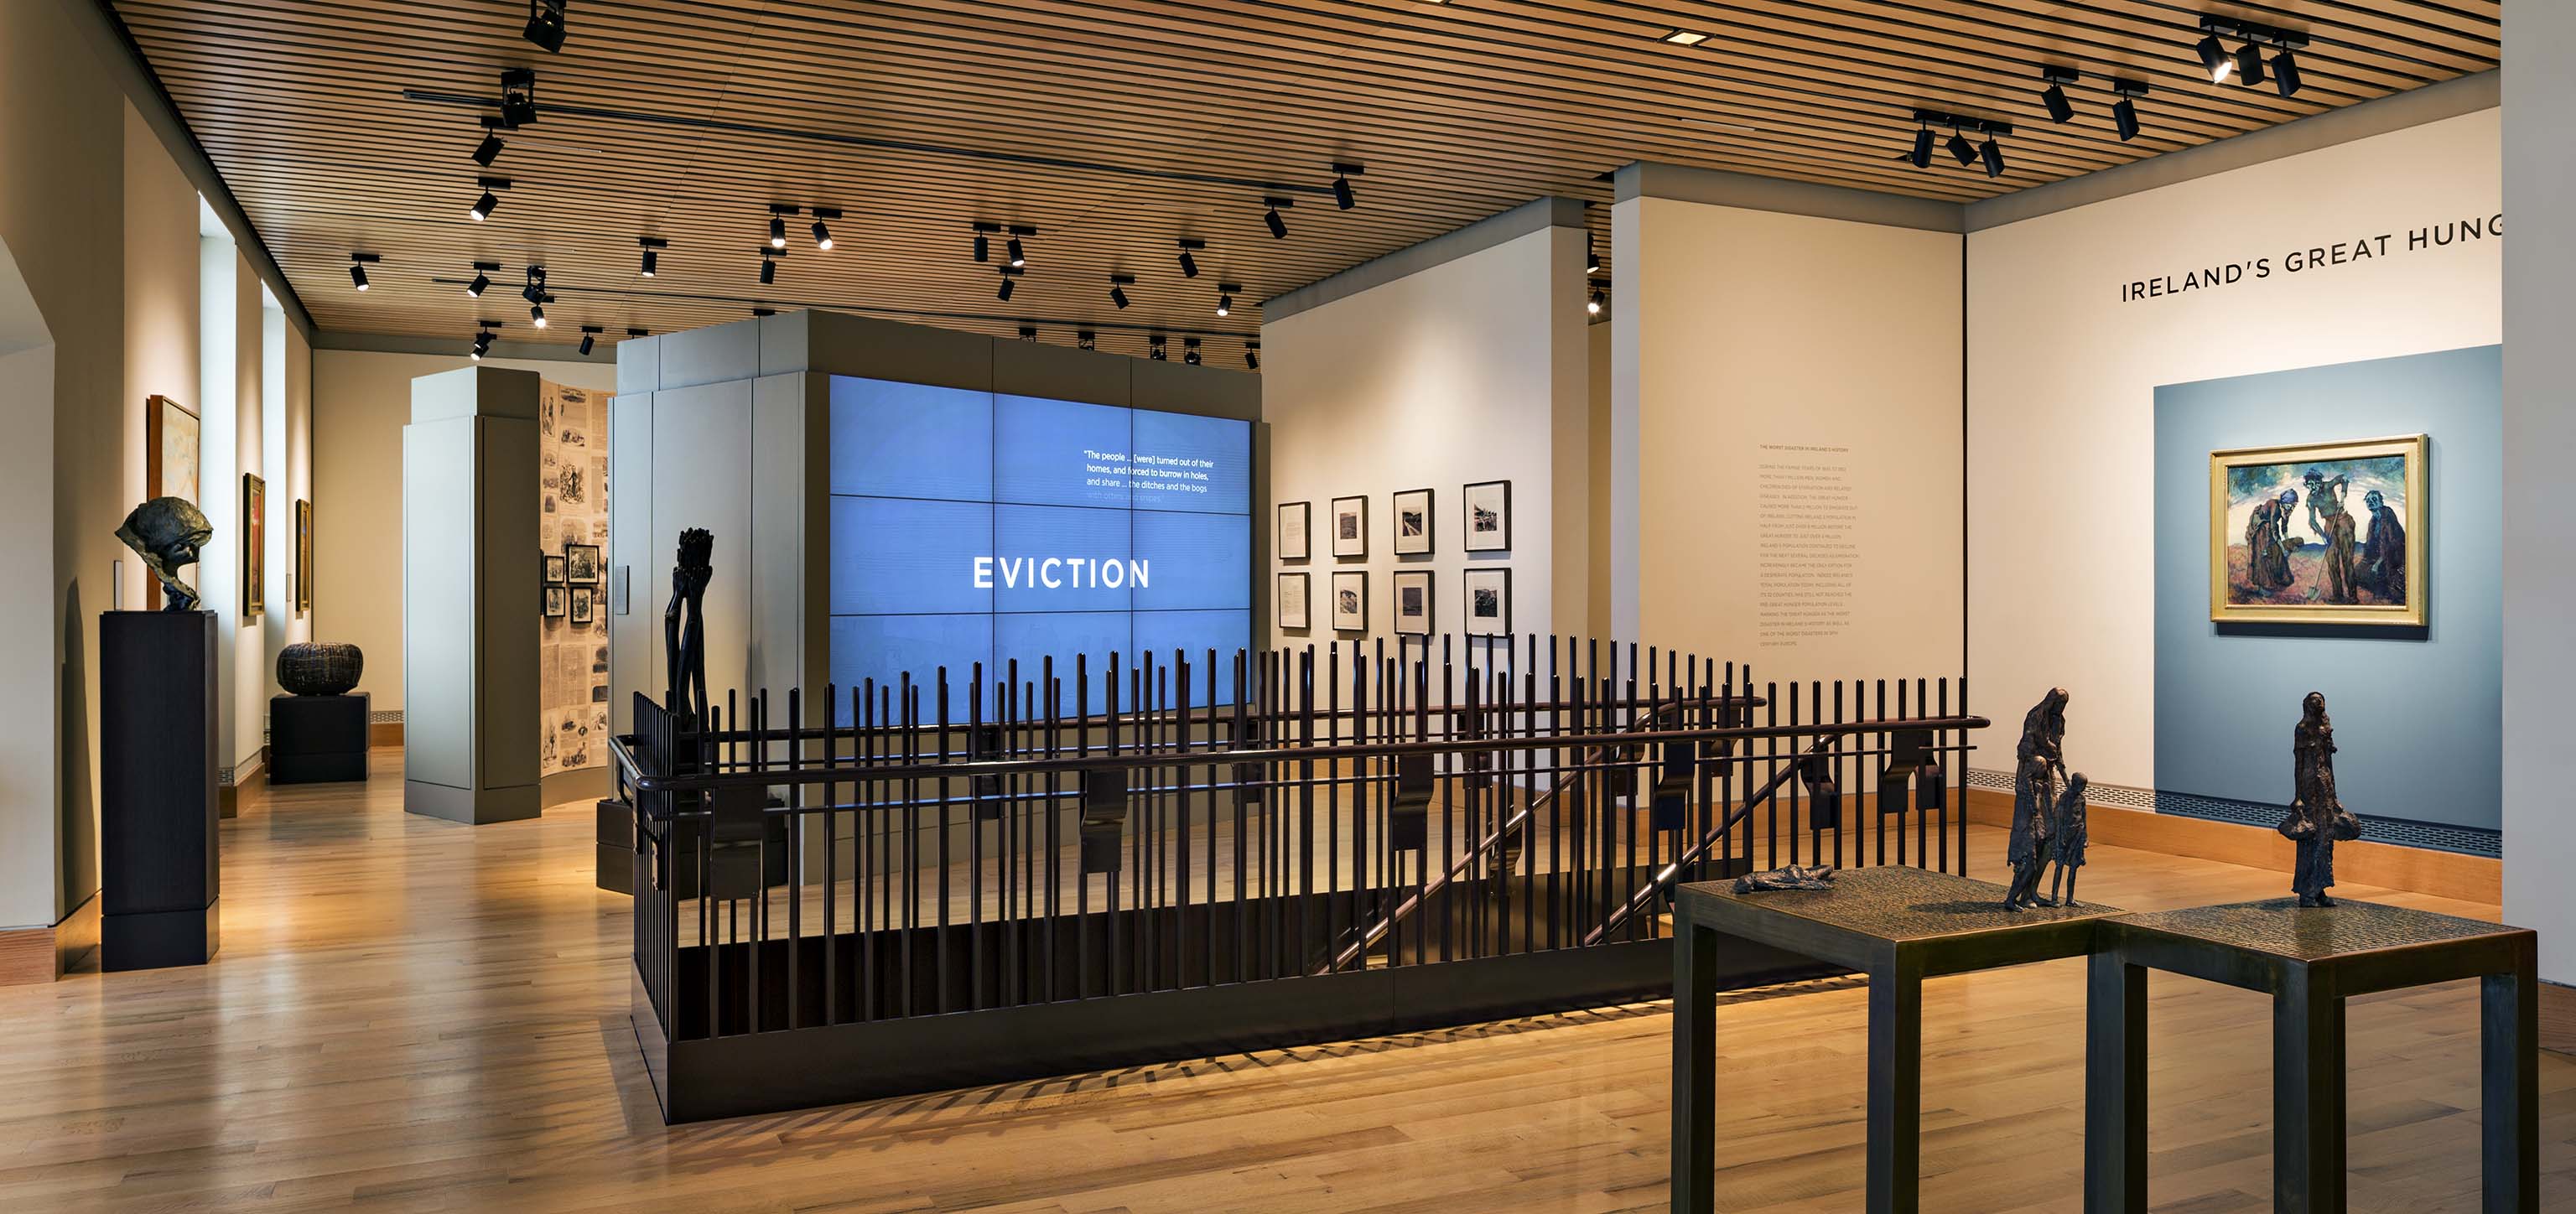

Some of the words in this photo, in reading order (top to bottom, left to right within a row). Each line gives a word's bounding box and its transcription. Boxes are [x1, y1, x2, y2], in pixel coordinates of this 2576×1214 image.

[2122, 258, 2270, 303] IRELAND'S
[2284, 234, 2392, 272] GREAT
[1083, 449, 1100, 459] "The
[1102, 453, 1125, 462] people
[1134, 454, 1156, 464] [were]
[1157, 456, 1178, 465] turned
[1191, 459, 1199, 467] of
[1199, 459, 1213, 468] their
[1087, 463, 1112, 475] homes,
[1113, 466, 1126, 475] and
[1128, 466, 1150, 476] forced
[1159, 469, 1182, 478] burrow
[1183, 470, 1190, 479] in
[1191, 471, 1209, 481] holes,
[1102, 478, 1120, 487] share
[1129, 480, 1140, 489] the
[1141, 480, 1165, 490] ditches
[1180, 483, 1191, 491] the
[1192, 484, 1208, 493] bogs
[974, 557, 1149, 589] EVICTION
